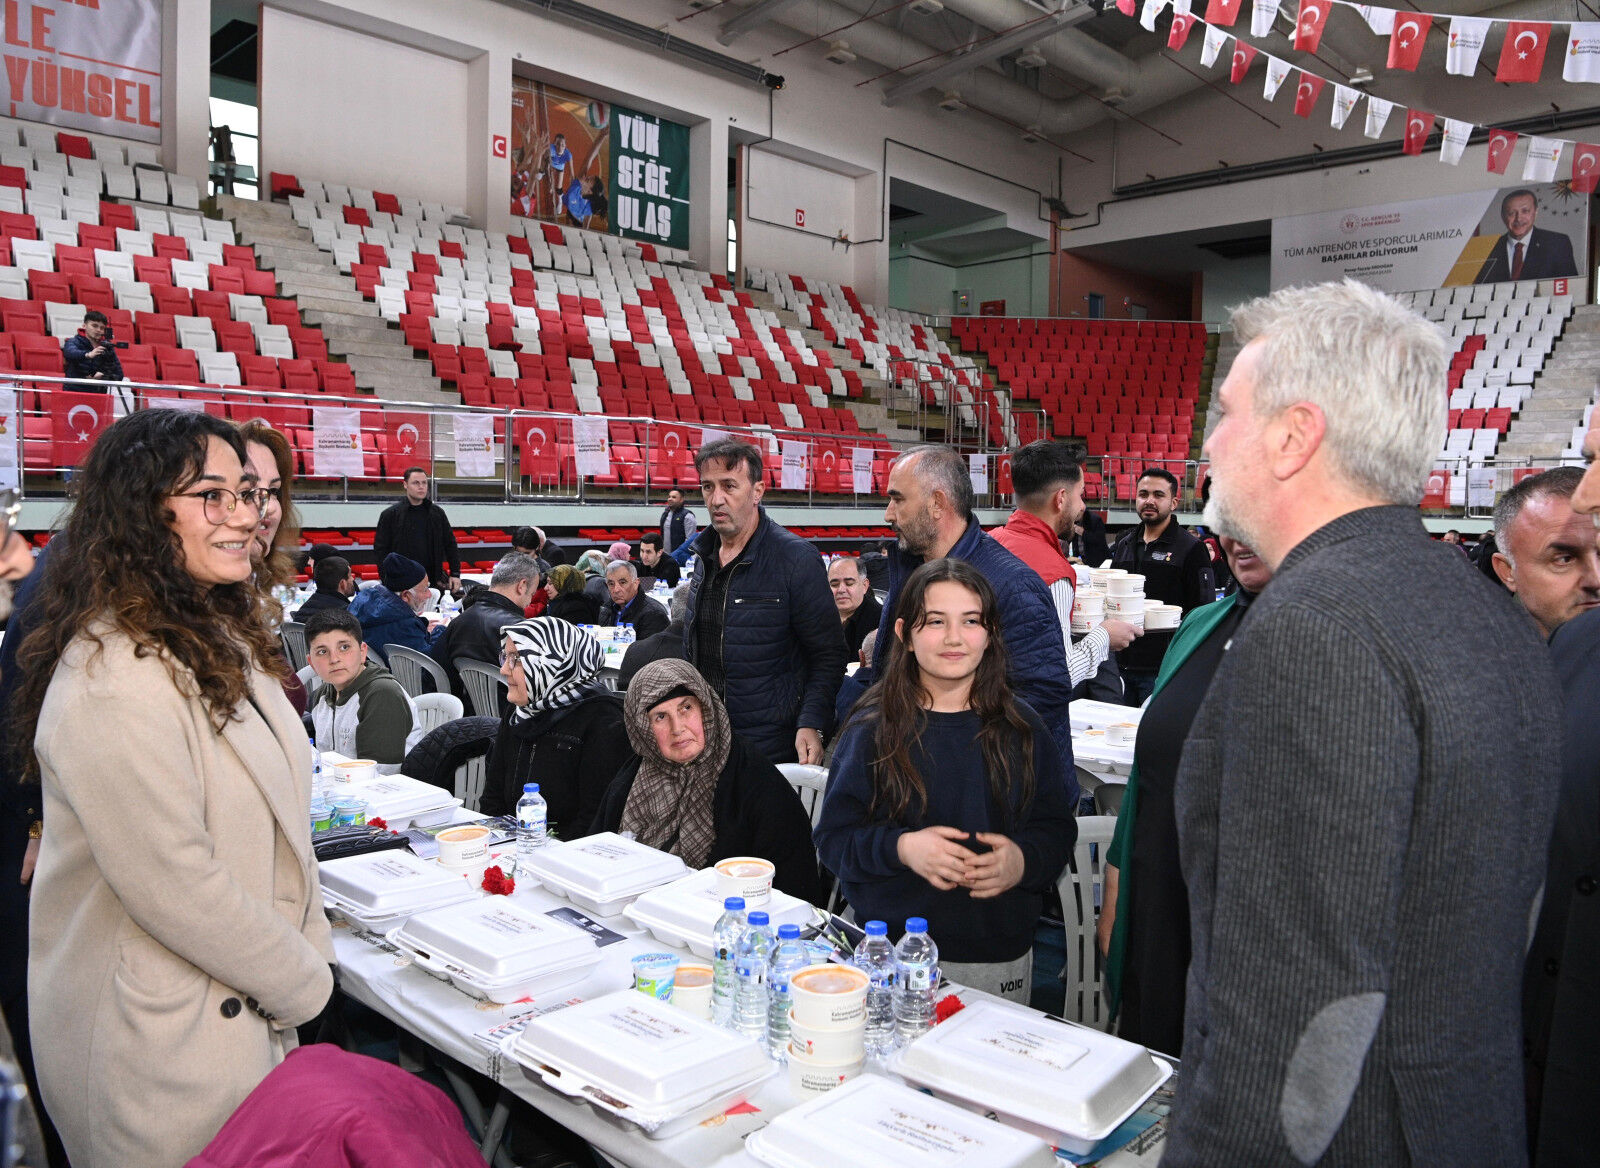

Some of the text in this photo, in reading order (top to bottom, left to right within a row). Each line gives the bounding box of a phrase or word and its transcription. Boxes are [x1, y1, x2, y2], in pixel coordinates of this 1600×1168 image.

[5, 0, 56, 54] LE
[4, 54, 161, 129] YÜKSEL
[494, 139, 505, 155] C
[618, 112, 660, 158] YÜK
[618, 154, 672, 200] SEĞE
[618, 194, 672, 242] ULAŞ
[796, 211, 804, 224] D
[1284, 228, 1462, 258] TÜM ANTRENÖR VE SPORCULARIMIZA
[1321, 245, 1418, 263] BAŞARILAR DİLİYORUM
[1555, 280, 1564, 293] E
[1000, 978, 1024, 994] VOID
